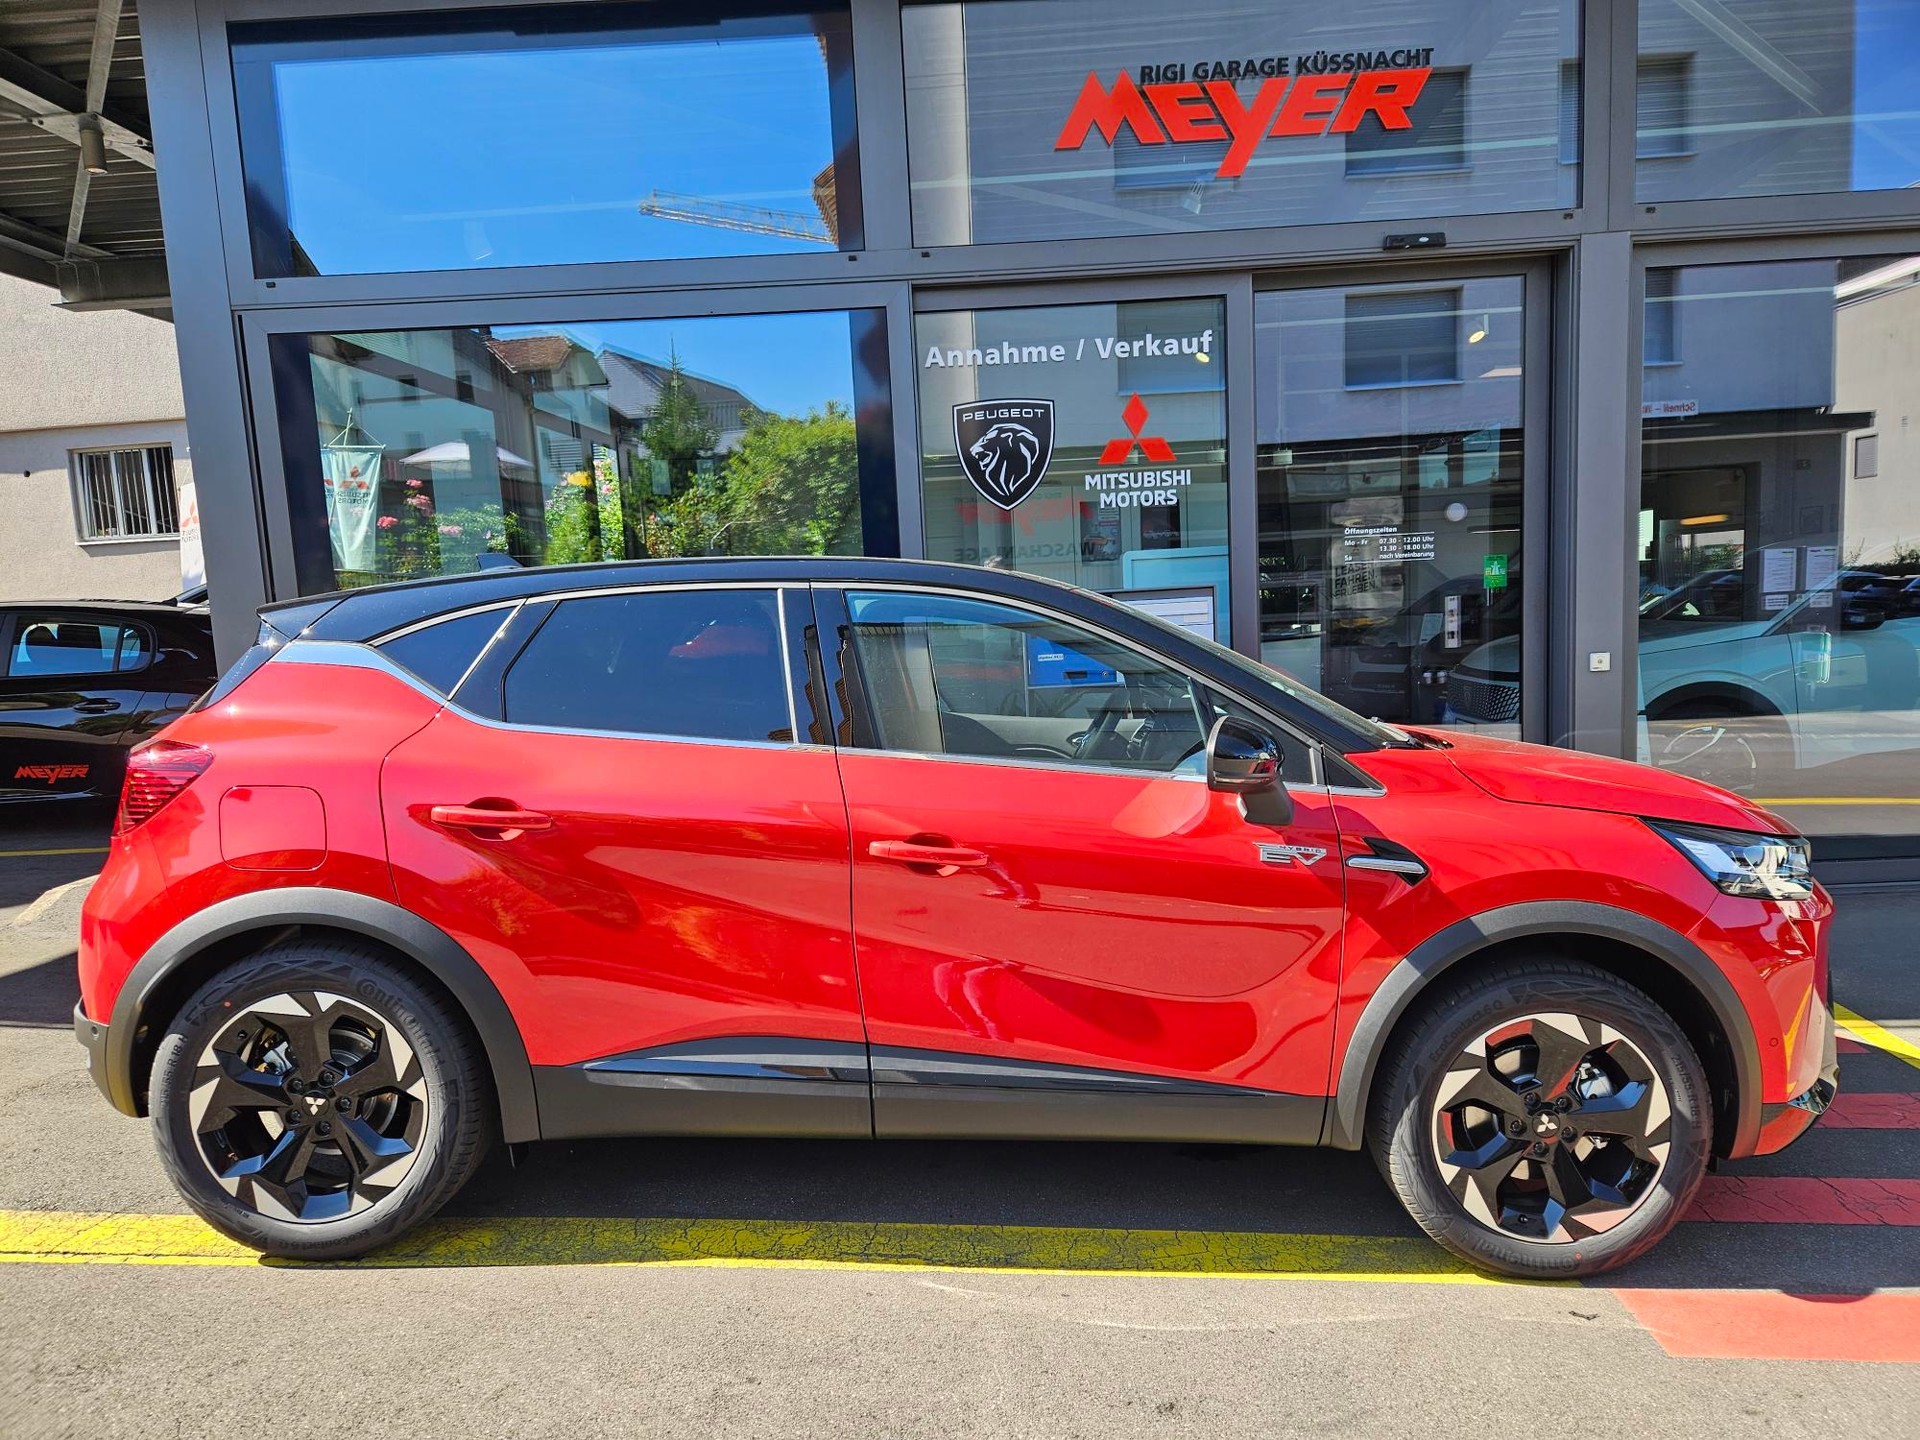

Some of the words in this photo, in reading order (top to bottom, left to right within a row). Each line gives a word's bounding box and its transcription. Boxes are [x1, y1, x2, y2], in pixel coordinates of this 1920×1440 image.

[1140, 62, 1186, 83] RIGI
[1193, 57, 1289, 80] GARAGE
[1297, 47, 1434, 75] KÜSSNACHT
[1053, 67, 1433, 178] MEYER
[924, 341, 1066, 368] Annahme
[1076, 338, 1084, 360] /
[1095, 330, 1213, 360] Verkauf
[962, 408, 1045, 423] PEUGEOT
[1084, 469, 1192, 491] MITSUBISHI
[1099, 488, 1178, 509] MOTORS
[1344, 527, 1398, 536] Öffnungszeiten
[1394, 551, 1435, 559] Vereinbarung
[14, 766, 89, 784] MEYER
